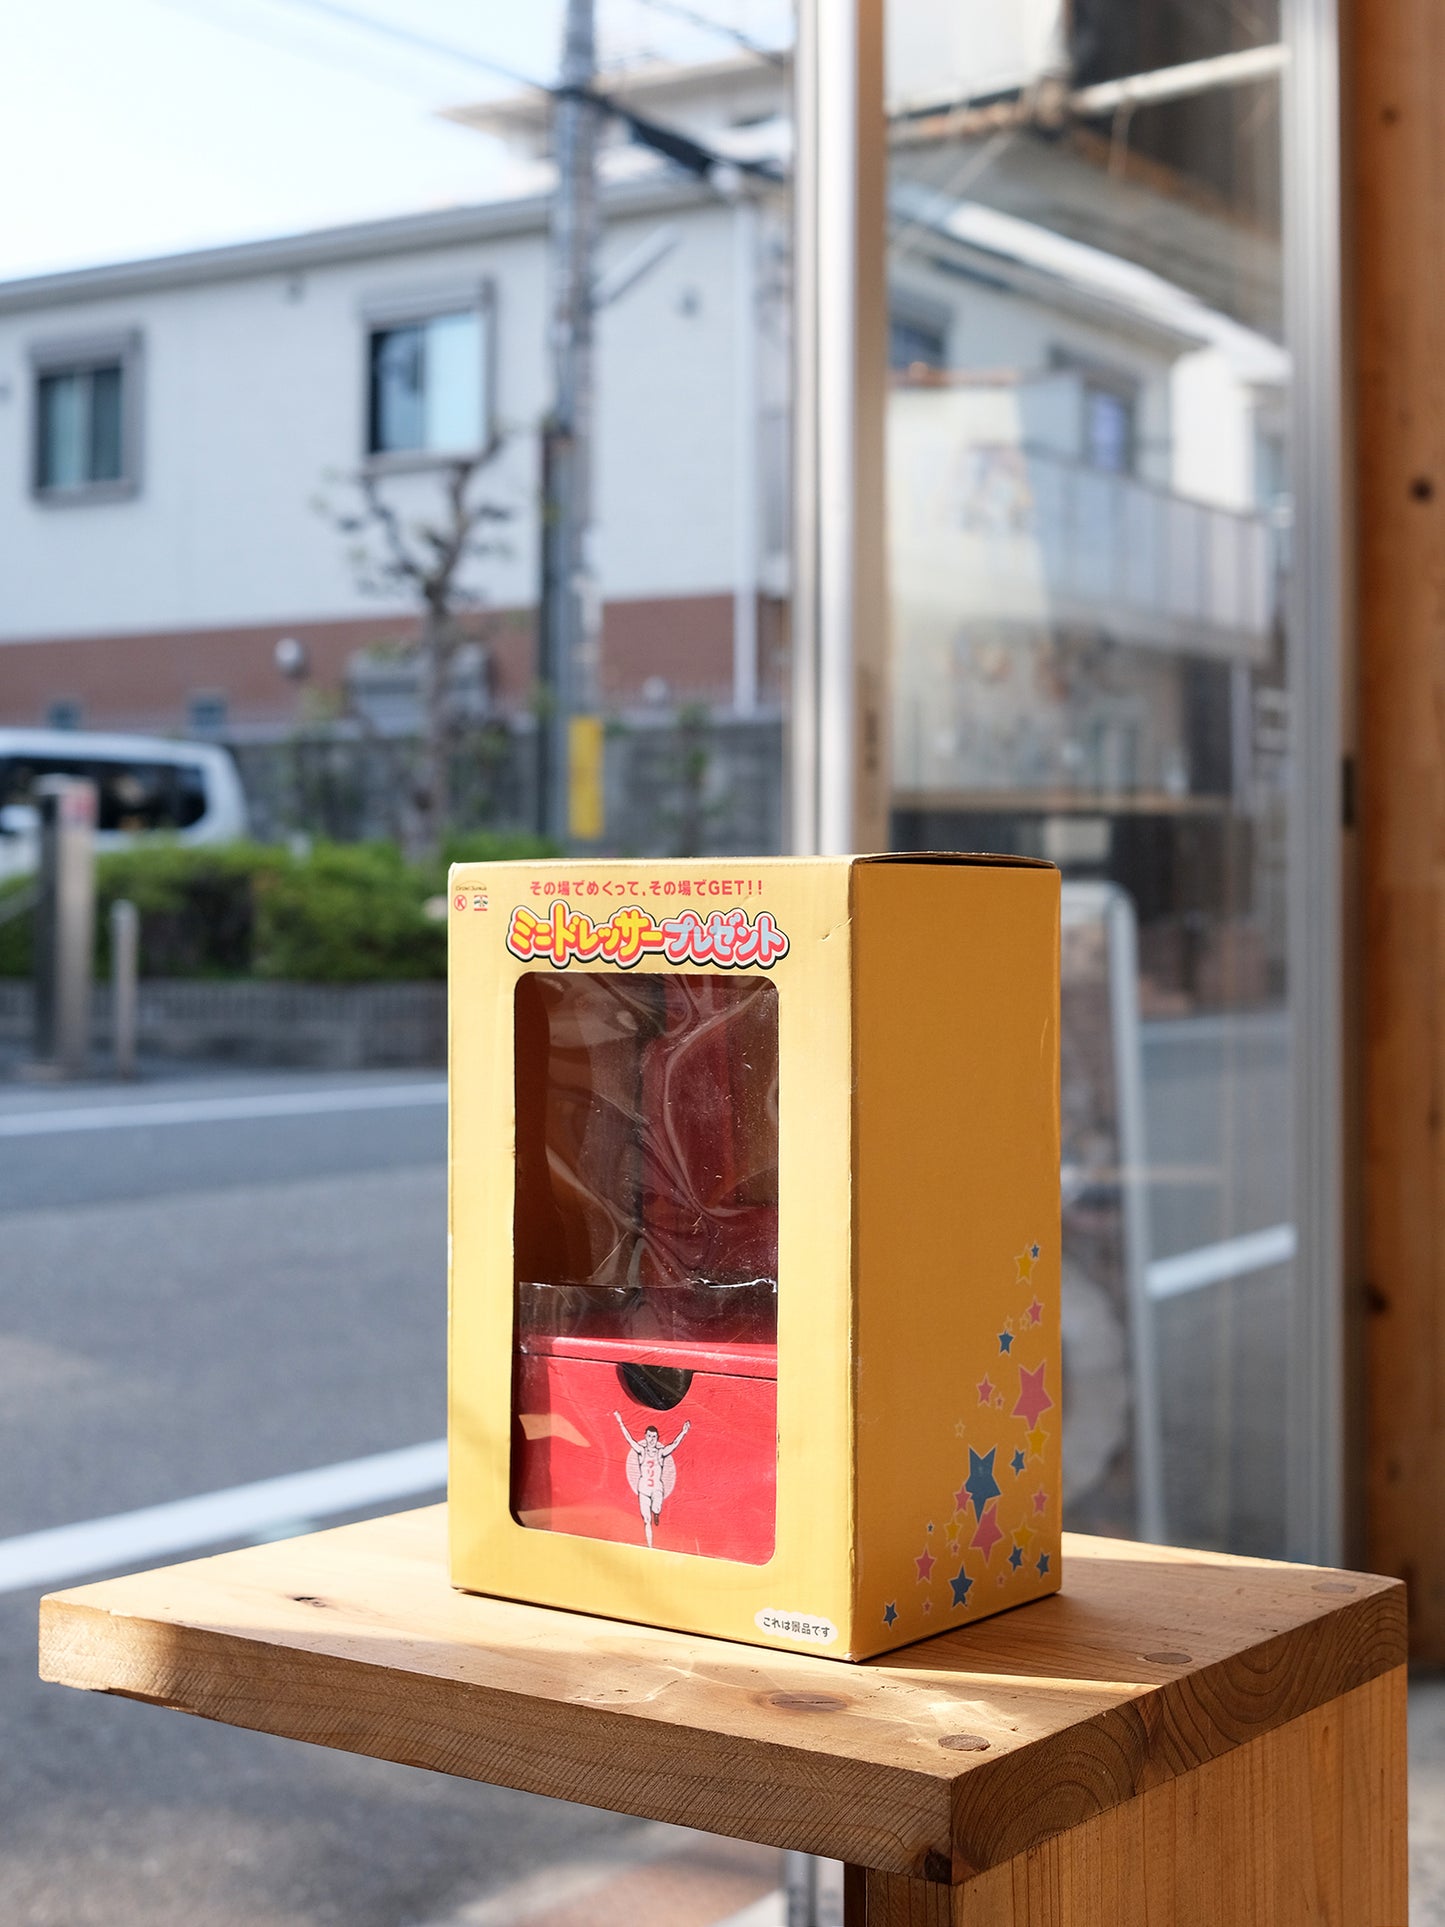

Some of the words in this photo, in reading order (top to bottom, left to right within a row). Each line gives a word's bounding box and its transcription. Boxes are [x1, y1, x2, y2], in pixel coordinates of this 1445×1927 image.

[456, 896, 466, 910] K
[763, 1616, 830, 1638] これは景品です
